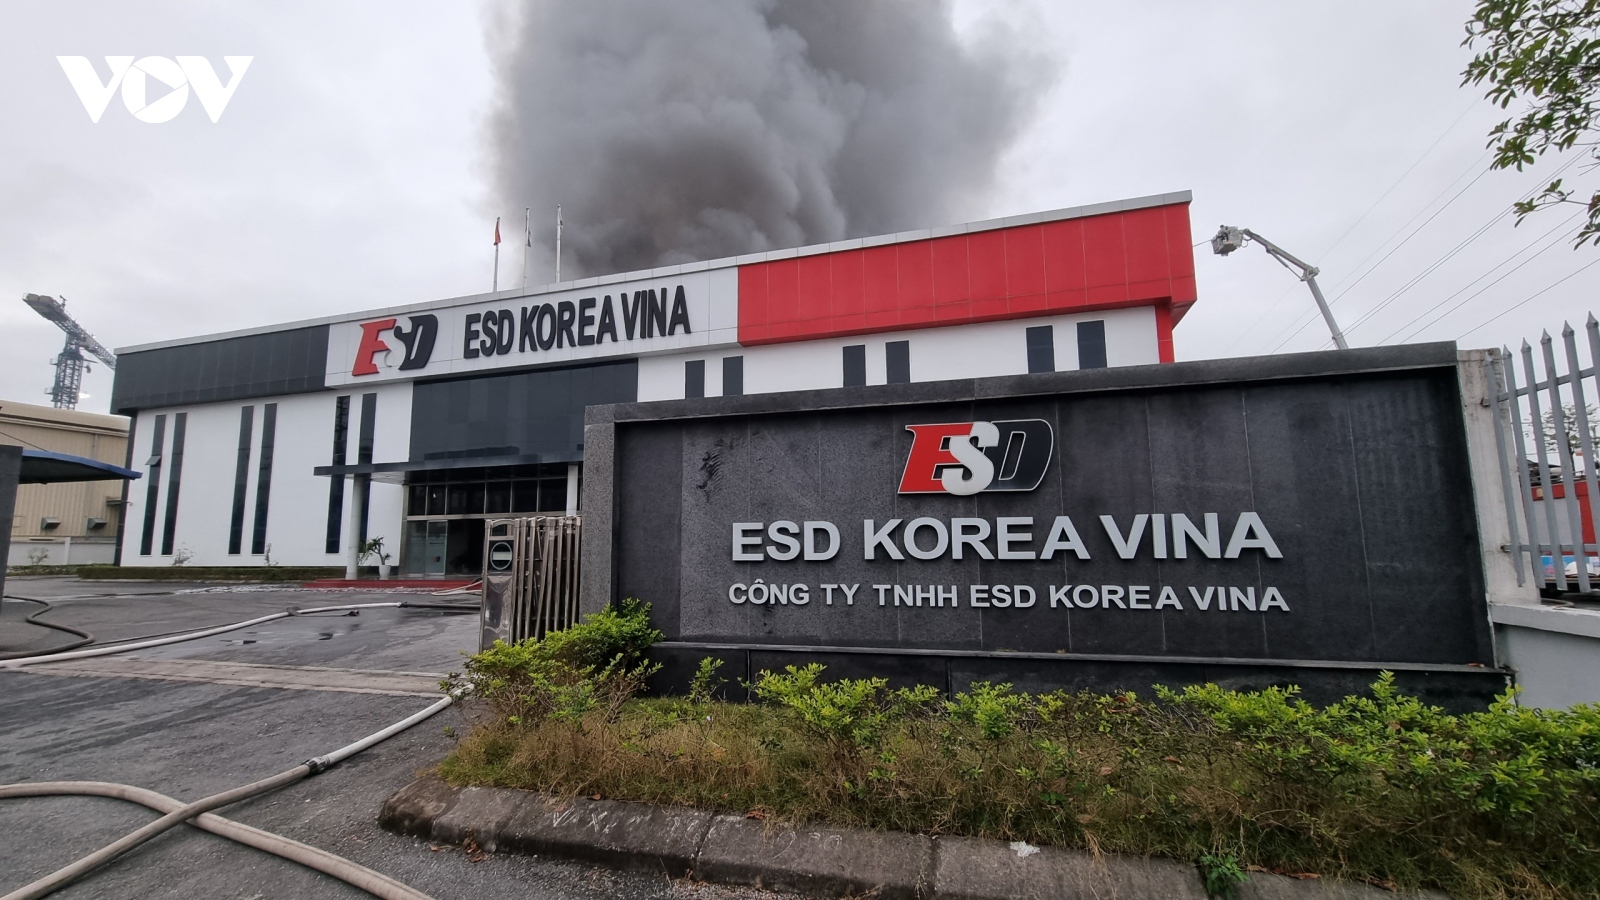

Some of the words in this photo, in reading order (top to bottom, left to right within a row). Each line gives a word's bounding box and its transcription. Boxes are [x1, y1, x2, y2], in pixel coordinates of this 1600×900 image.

[352, 314, 438, 376] ESD
[463, 309, 514, 359] ESD
[519, 295, 618, 353] KOREA
[621, 285, 691, 340] VINA
[898, 419, 1053, 495] ESD
[732, 520, 841, 561] ESD
[863, 516, 1091, 560] KOREA
[1099, 512, 1284, 559] VINA
[729, 579, 809, 605] CÔNG
[820, 584, 860, 605] TY
[872, 585, 958, 607] TNHH
[970, 585, 1036, 608] ESD
[1049, 585, 1183, 610] KOREA
[1188, 586, 1290, 611] VINA
